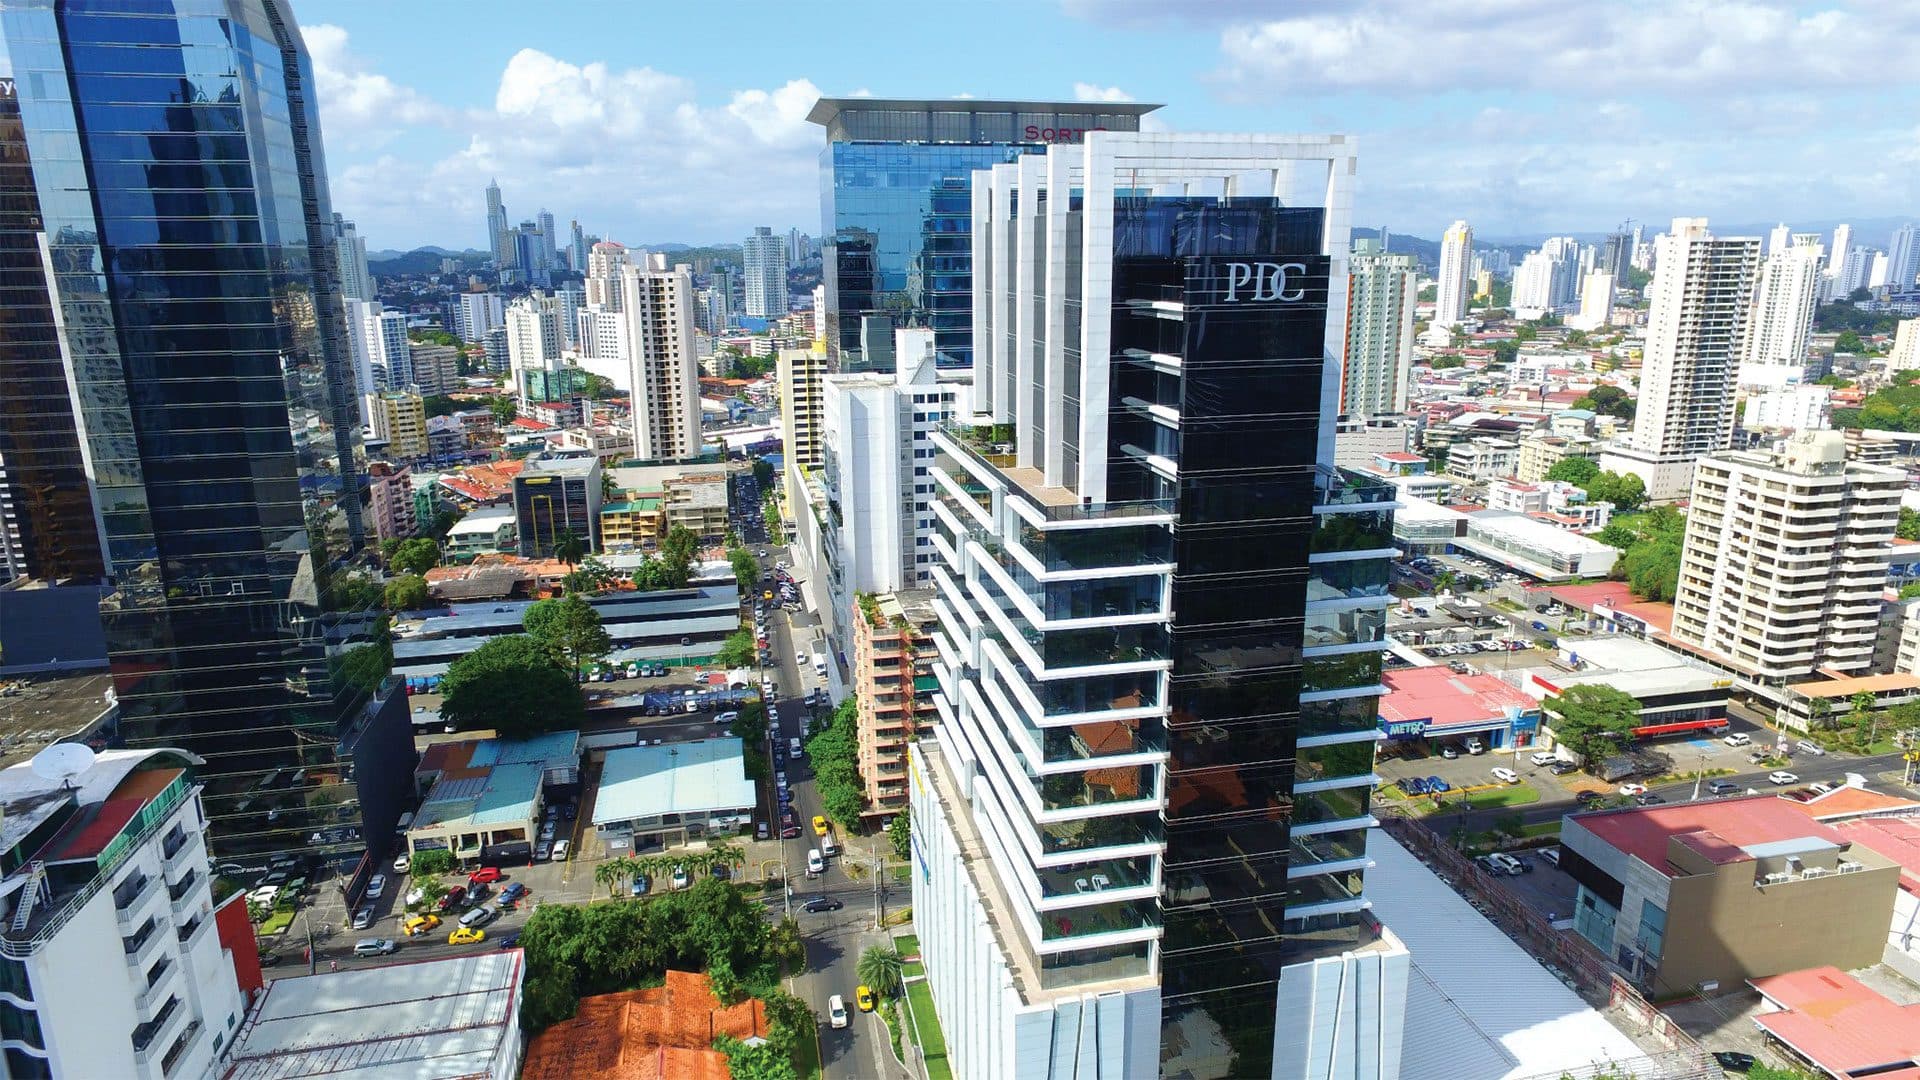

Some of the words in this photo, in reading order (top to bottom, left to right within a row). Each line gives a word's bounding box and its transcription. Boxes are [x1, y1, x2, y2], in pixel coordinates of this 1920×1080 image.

[1025, 125, 1108, 144] SORT
[1223, 262, 1306, 302] PDC
[1389, 721, 1425, 735] METRO
